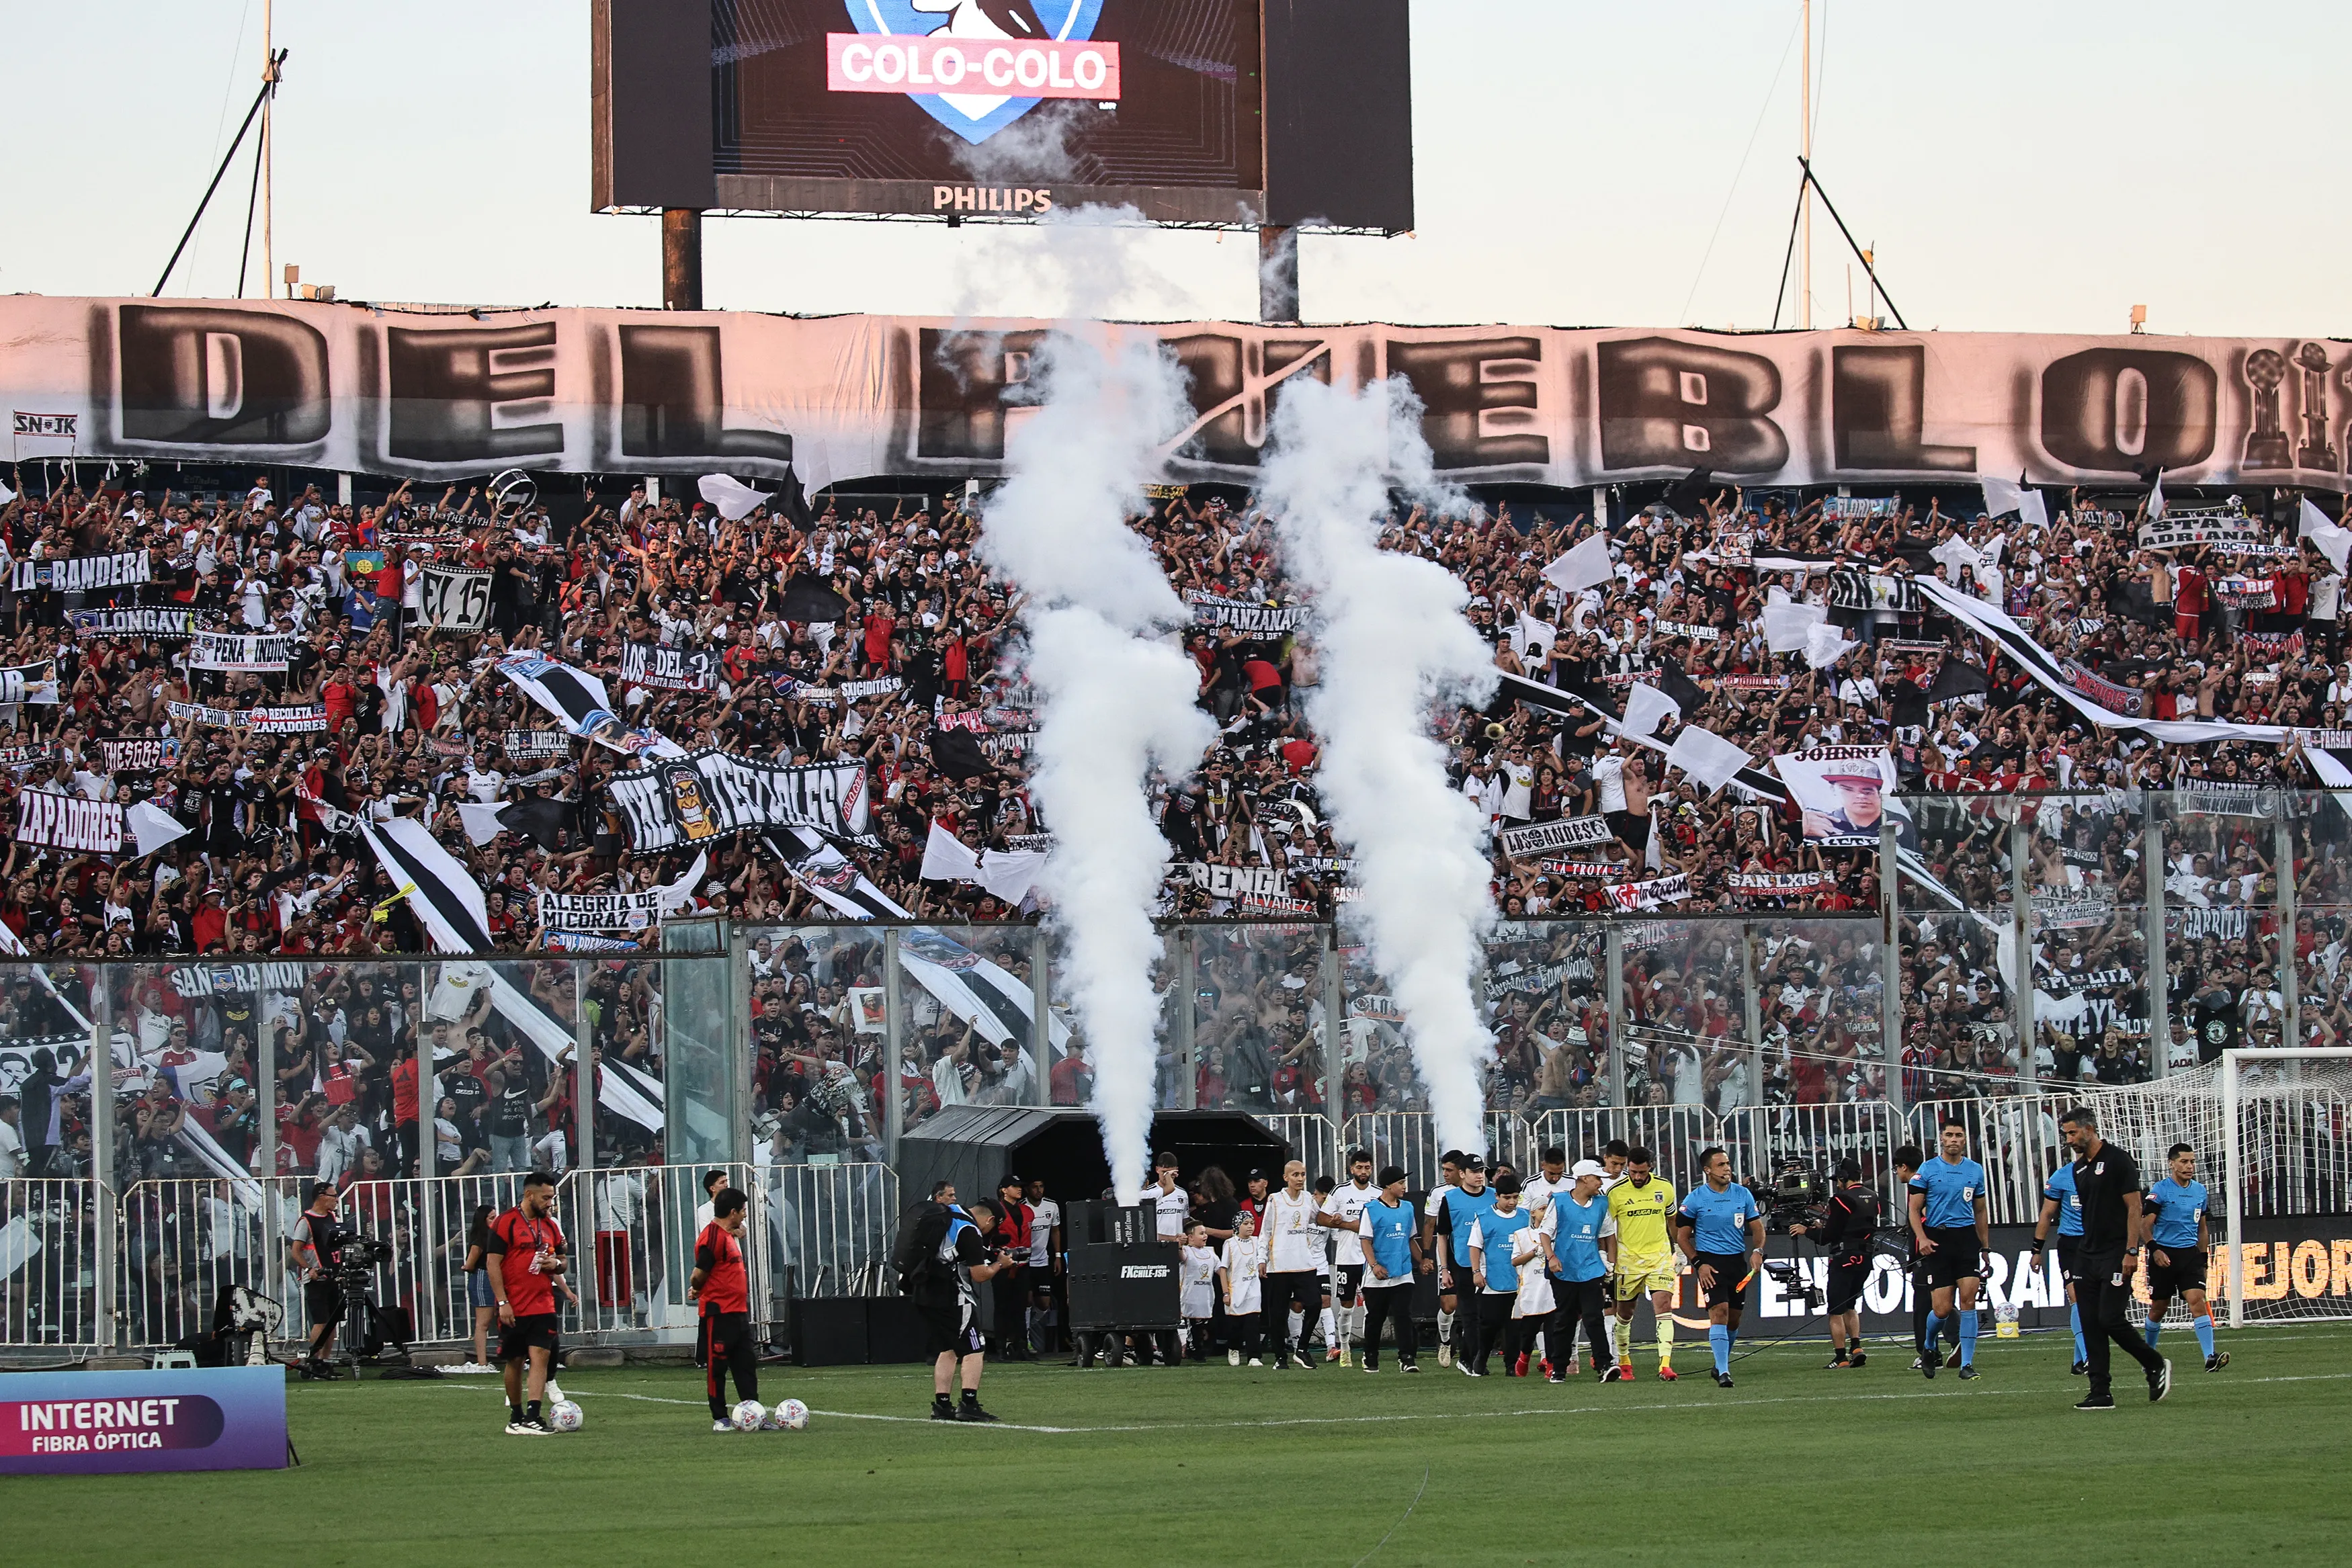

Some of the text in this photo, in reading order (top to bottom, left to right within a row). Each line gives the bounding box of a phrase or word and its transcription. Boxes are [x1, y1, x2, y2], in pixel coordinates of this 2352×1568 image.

[841, 42, 1106, 90] COLO-COLO
[933, 184, 1052, 214] PHILIPS
[118, 302, 794, 462] DEL
[15, 415, 77, 434] SN JK
[2151, 518, 2222, 533] STA
[12, 548, 151, 592] LA BANDERA
[456, 576, 493, 622] 15
[1656, 620, 1673, 631] LOS
[1678, 623, 1720, 638] KLLAYES
[214, 637, 291, 663] PEÑA INDIOS
[621, 642, 709, 691] LOS DEL 3
[644, 674, 686, 689] SANTA ROSA
[841, 678, 892, 698] SXICIDITAS
[268, 707, 313, 721] RECOLETA
[254, 719, 328, 733] ZAPADORES
[505, 732, 569, 750] LOS ANGELES
[1794, 746, 1883, 762] JOHNNY
[16, 790, 124, 853] ZAPADORES
[609, 775, 676, 850] THE
[1542, 821, 1594, 846] ANDES
[1552, 862, 1608, 875] LA TROYA
[1728, 874, 1770, 887] SAN
[1776, 871, 1820, 887] LXIS
[1758, 887, 1802, 896] MAIPX
[542, 892, 658, 912] ALEGRIA DE
[1243, 891, 1310, 913] ALVAREZ
[542, 910, 563, 928] MI
[230, 962, 304, 993] RAMON
[1634, 1209, 1652, 1217] JUGA
[1121, 1266, 1134, 1278] FX
[1337, 1271, 1347, 1285] 28
[20, 1399, 179, 1432] INTERNET
[32, 1430, 163, 1453] FIBRA ÓPTICA
